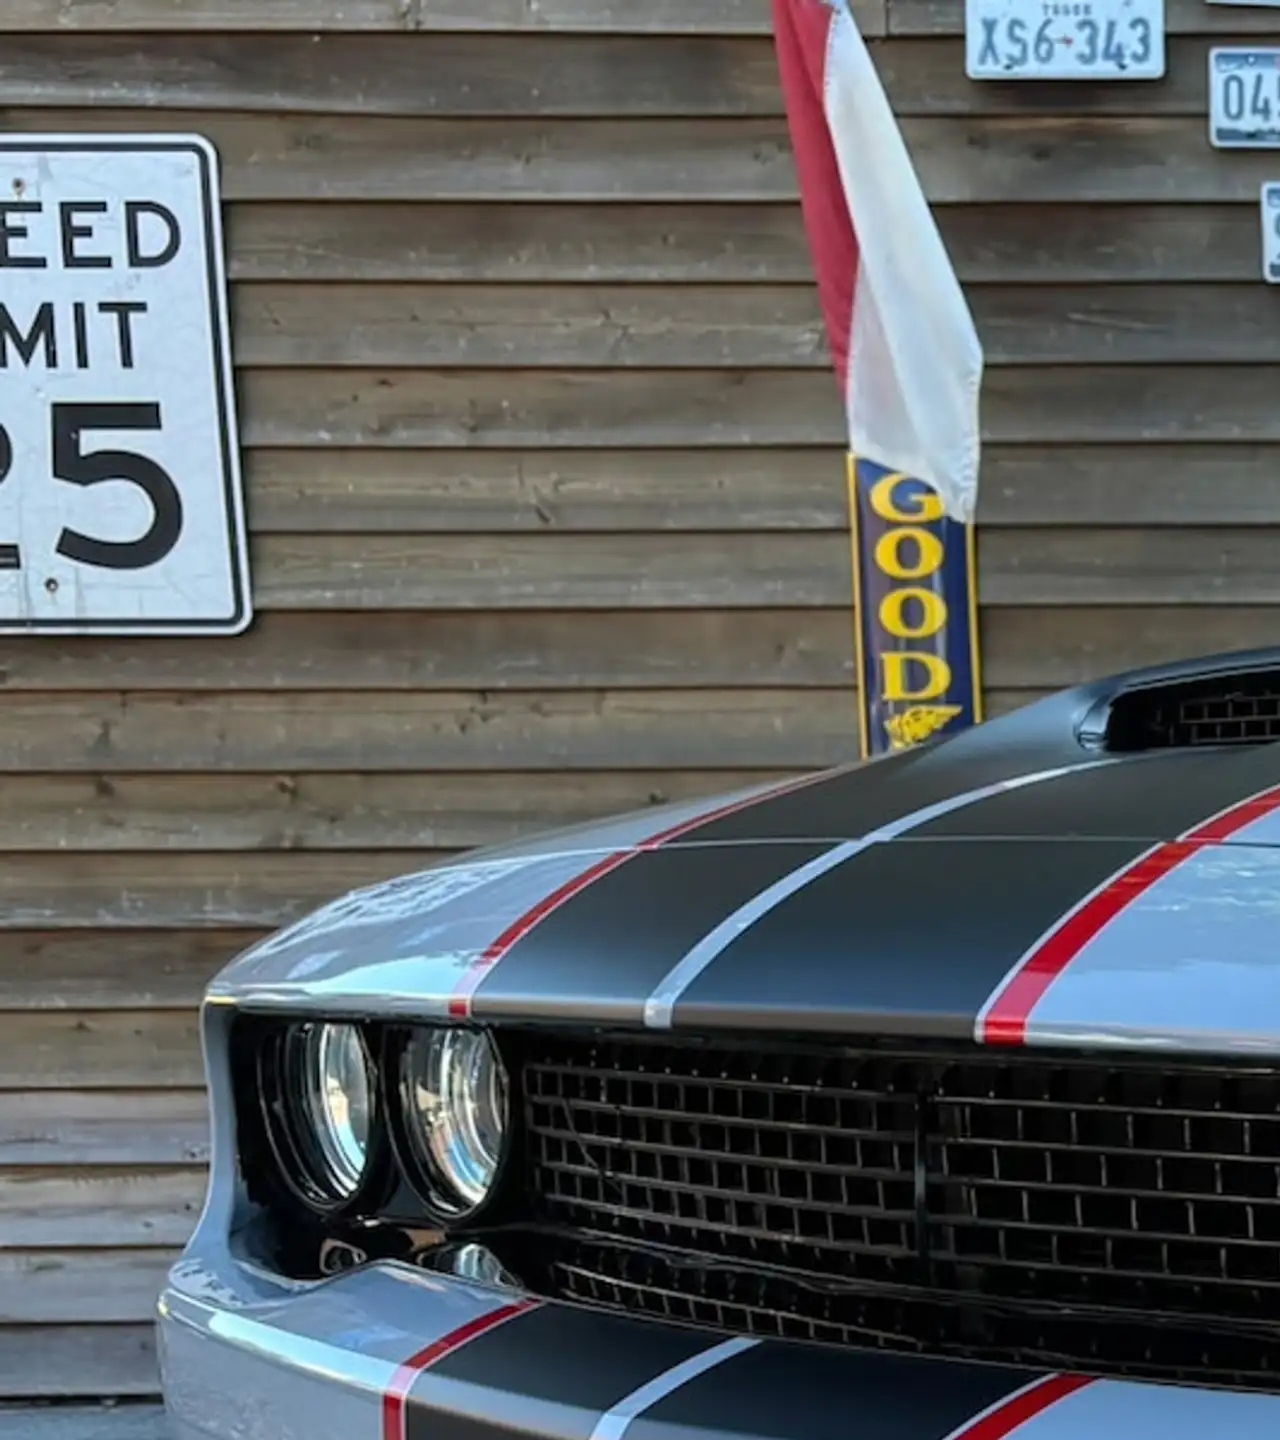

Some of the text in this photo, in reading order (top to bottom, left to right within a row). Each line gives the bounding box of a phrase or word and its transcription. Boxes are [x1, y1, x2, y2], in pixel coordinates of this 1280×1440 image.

[977, 17, 1151, 66] XS6 343
[0, 402, 184, 571] 5
[869, 473, 952, 701] GOOD
